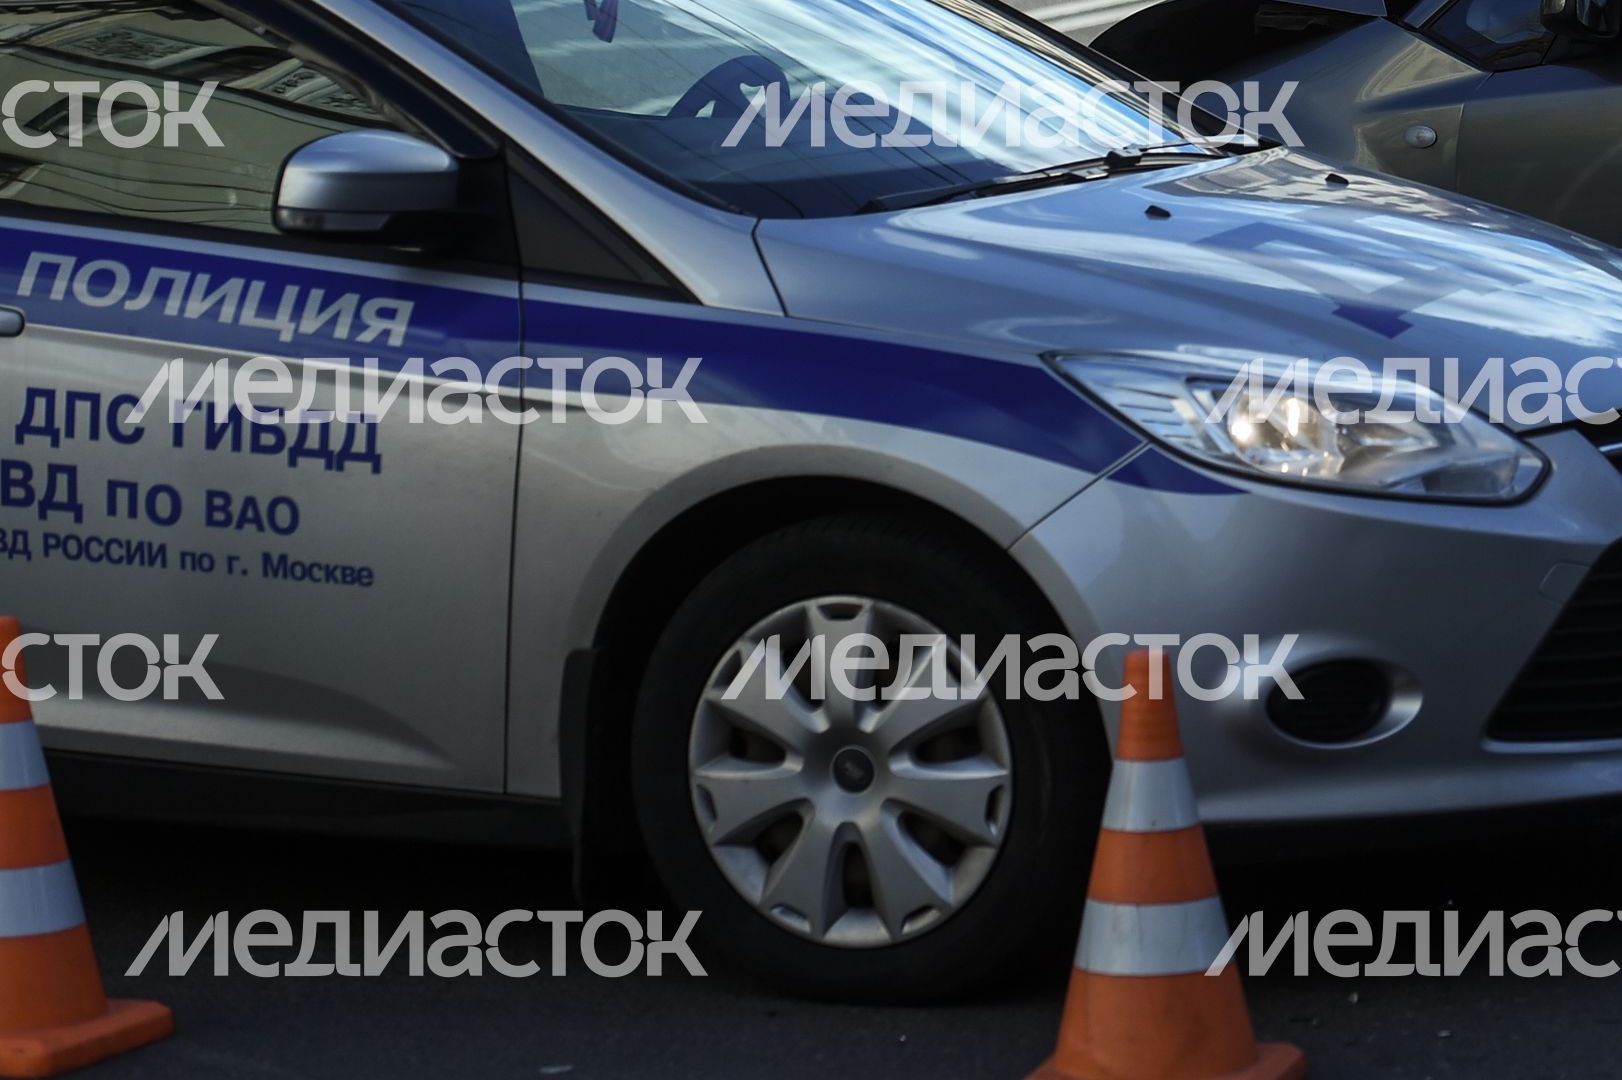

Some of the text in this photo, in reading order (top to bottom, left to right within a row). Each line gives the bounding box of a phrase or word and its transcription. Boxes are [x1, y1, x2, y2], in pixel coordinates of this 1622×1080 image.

[16, 250, 415, 347] ПОЛИЦИЯ
[15, 387, 382, 474] ДПС ГИБДД
[205, 489, 300, 536] ВАО
[43, 532, 167, 569] РОССИИ
[180, 551, 215, 573] по
[226, 555, 248, 576] г.
[261, 551, 374, 587] Москве
